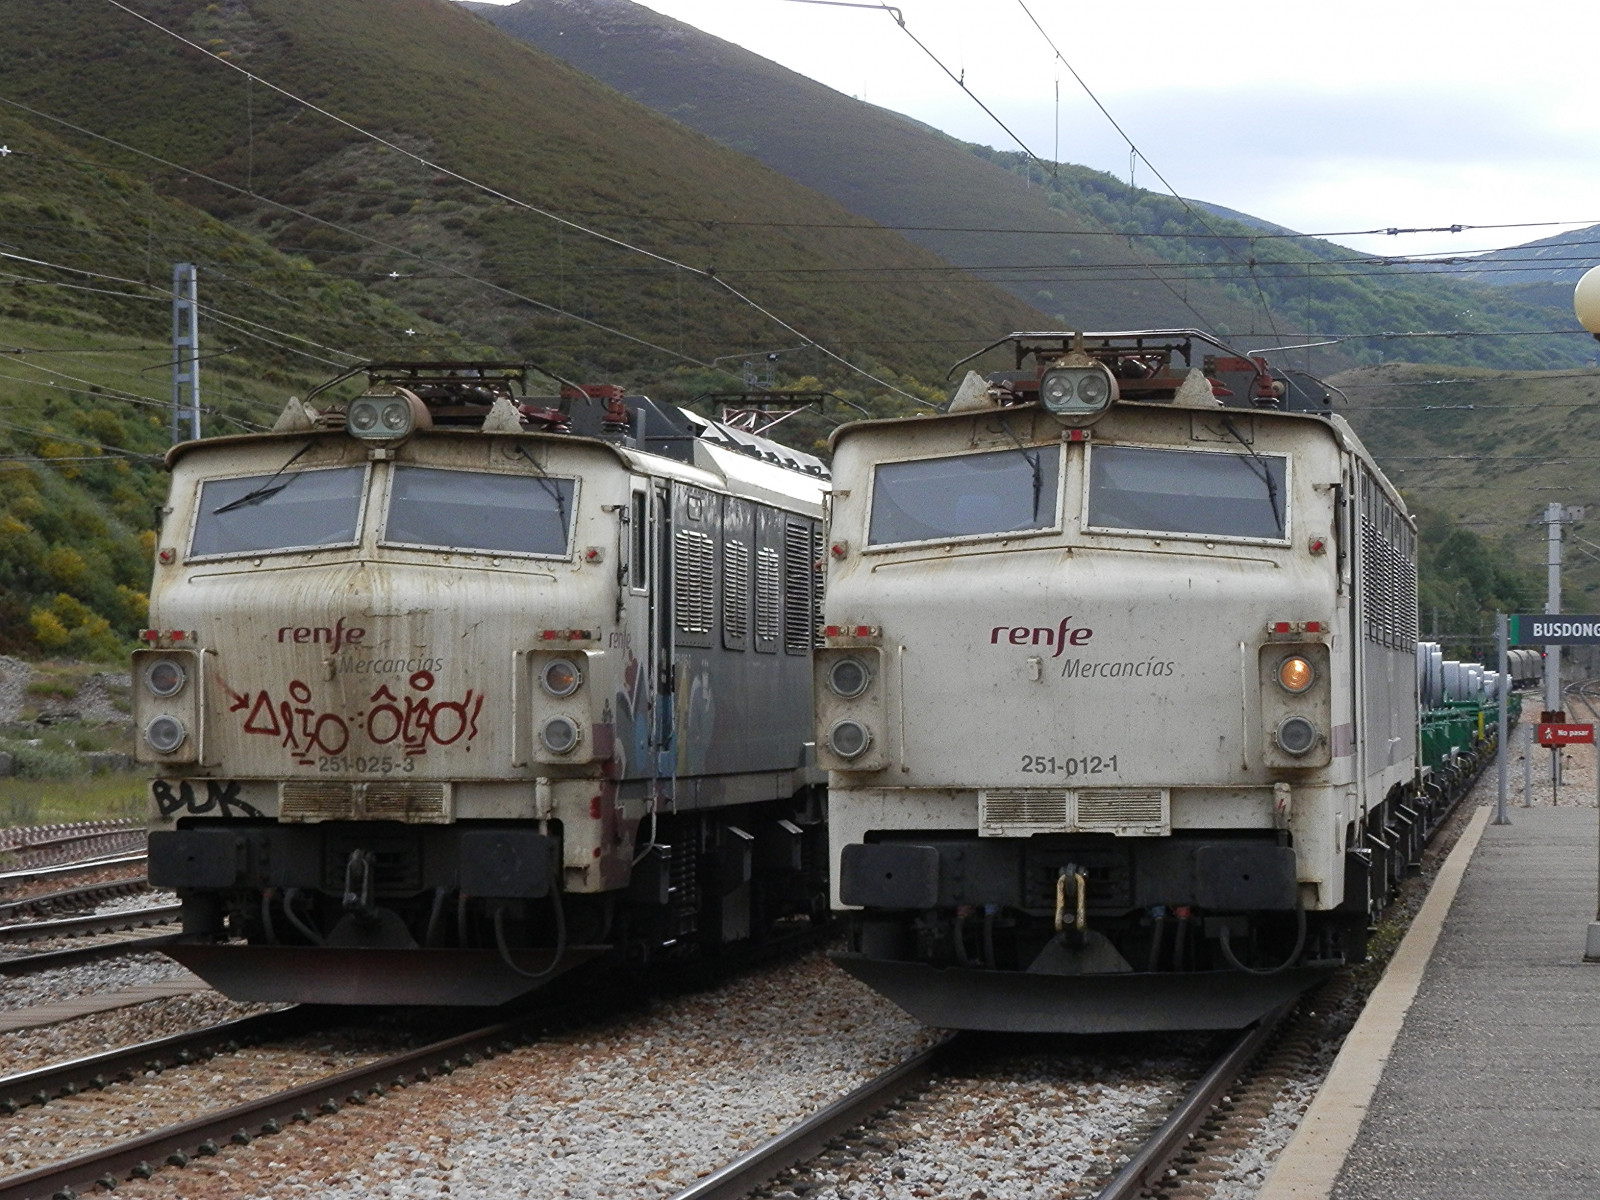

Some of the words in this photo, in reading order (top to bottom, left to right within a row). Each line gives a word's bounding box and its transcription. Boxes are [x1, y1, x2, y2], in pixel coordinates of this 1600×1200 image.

[278, 616, 366, 655] renfe
[608, 621, 632, 659] renfe
[990, 615, 1094, 658] renfe
[1533, 622, 1600, 637] BUSDONG
[339, 654, 444, 675] Mercancías
[1061, 656, 1175, 678] Mercancías
[1557, 729, 1568, 737] No
[1569, 730, 1590, 738] pasar
[318, 756, 416, 774] 251-025-3
[1020, 754, 1119, 776] 251-012-1
